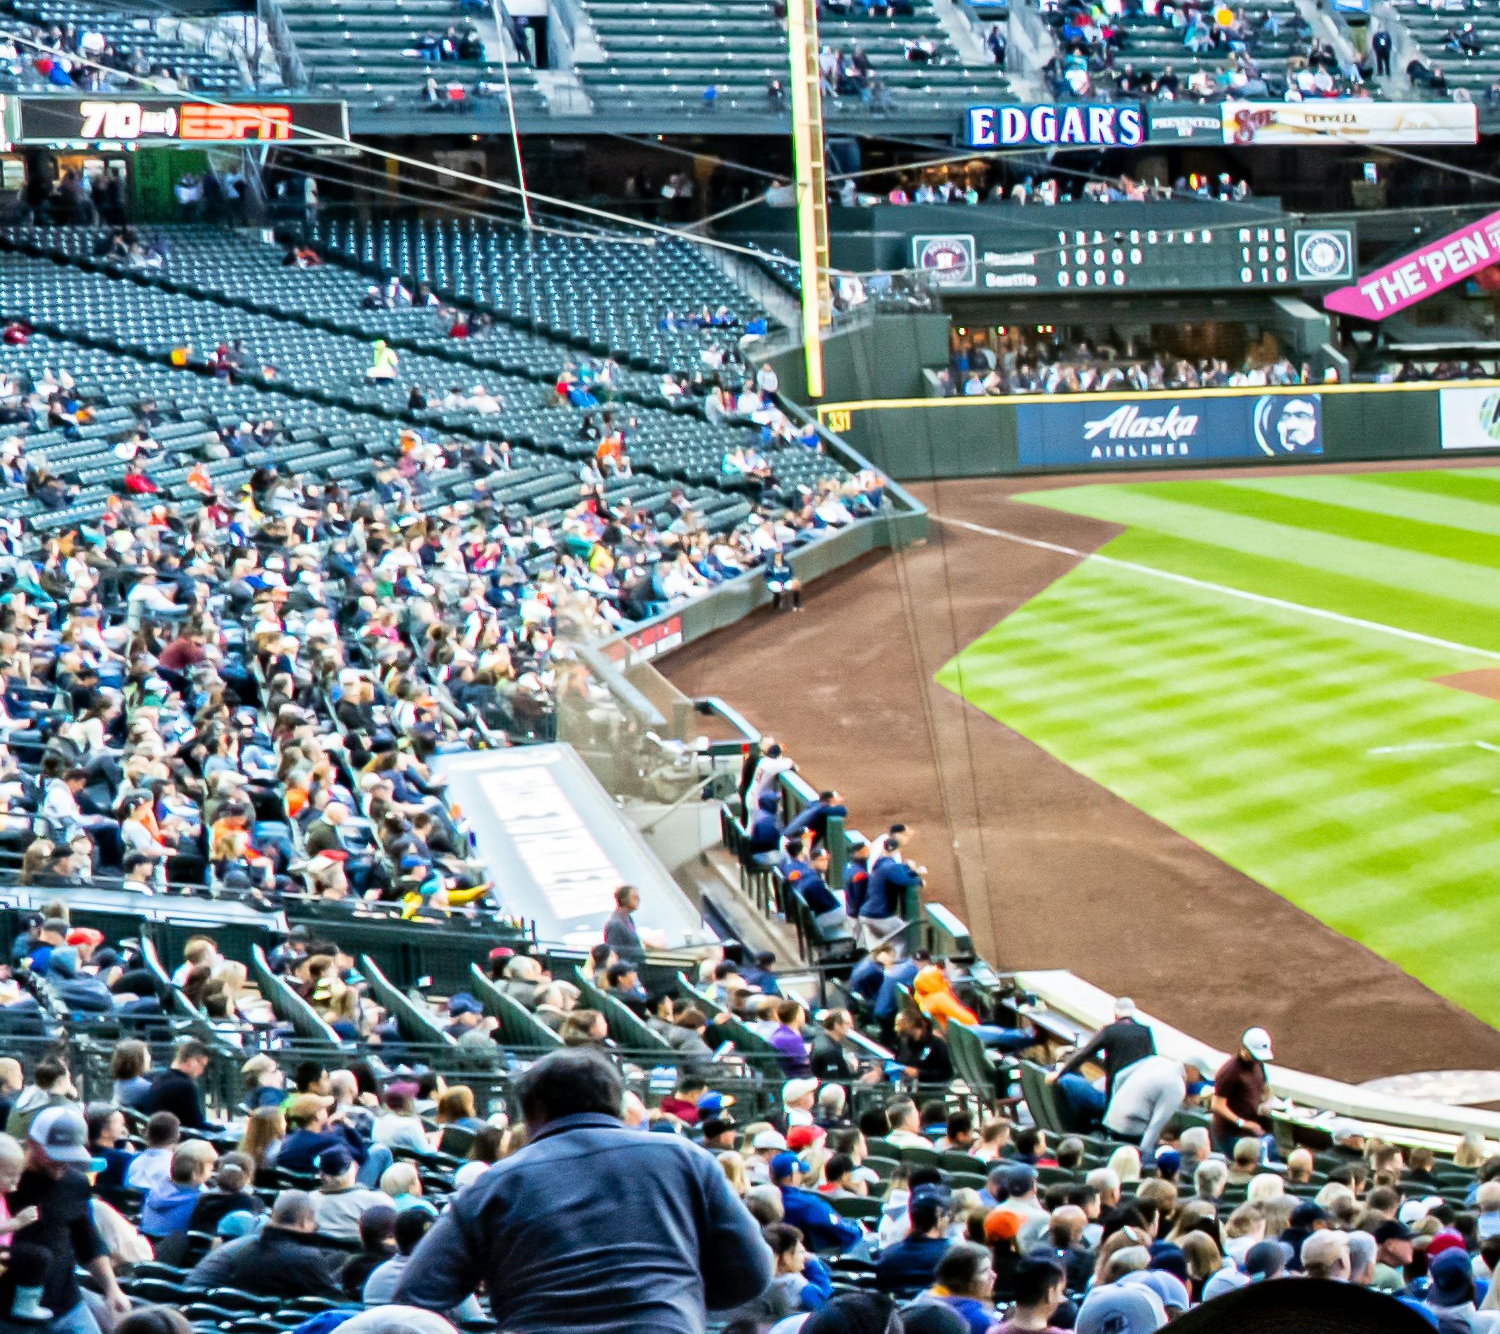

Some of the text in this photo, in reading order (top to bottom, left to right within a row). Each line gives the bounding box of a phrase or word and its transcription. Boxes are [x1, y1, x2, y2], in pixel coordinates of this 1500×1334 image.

[180, 104, 292, 140] ESPN
[968, 107, 1143, 146] EDGAR'S
[1361, 262, 1426, 312] THE
[828, 410, 851, 432] 331
[1083, 404, 1198, 441] Alaska
[1091, 443, 1188, 458] AIRLINES
